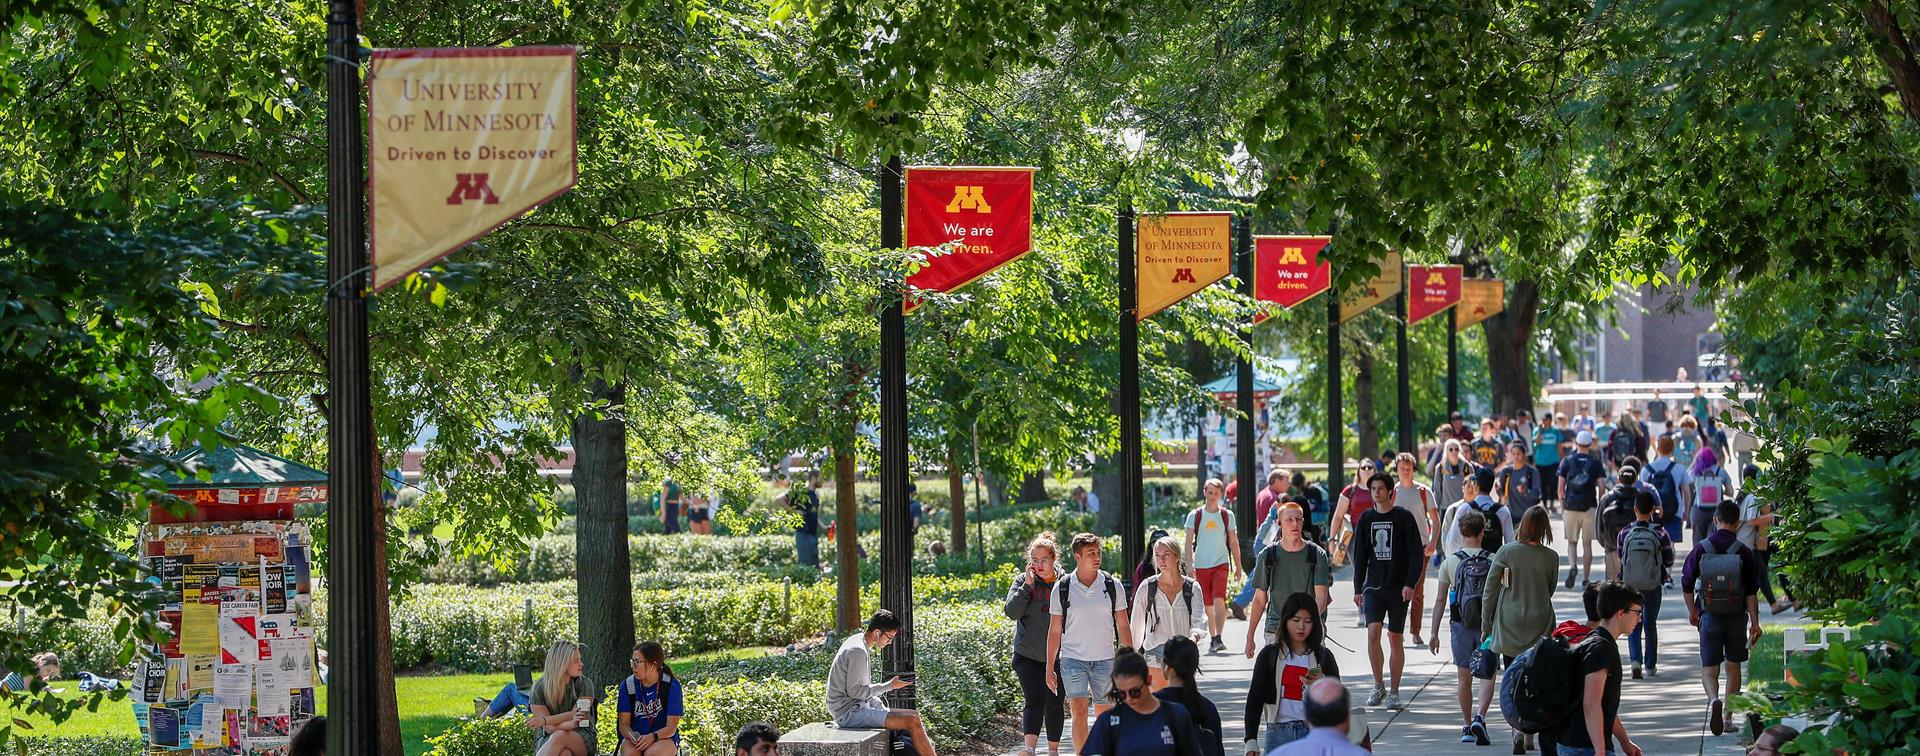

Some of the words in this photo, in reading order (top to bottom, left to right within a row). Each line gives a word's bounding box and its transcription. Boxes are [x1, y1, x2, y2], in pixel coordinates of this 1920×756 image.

[402, 79, 542, 101] UNIVERSITY
[387, 114, 416, 132] OF
[423, 109, 557, 132] MINNESOTA
[387, 146, 447, 162] Driven
[453, 147, 471, 161] to
[478, 145, 557, 160] Discover
[943, 223, 967, 236] We
[970, 226, 994, 237] are
[1152, 227, 1216, 237] UNIVERSITY
[948, 242, 994, 254] riven.
[1145, 241, 1159, 251] OF
[1161, 239, 1222, 250] MINNESOTA
[1277, 269, 1292, 279] We
[1294, 271, 1309, 279] are
[1277, 280, 1308, 290] driven.
[1424, 288, 1435, 296] We
[266, 573, 282, 581] OW
[149, 661, 163, 670] SHO
